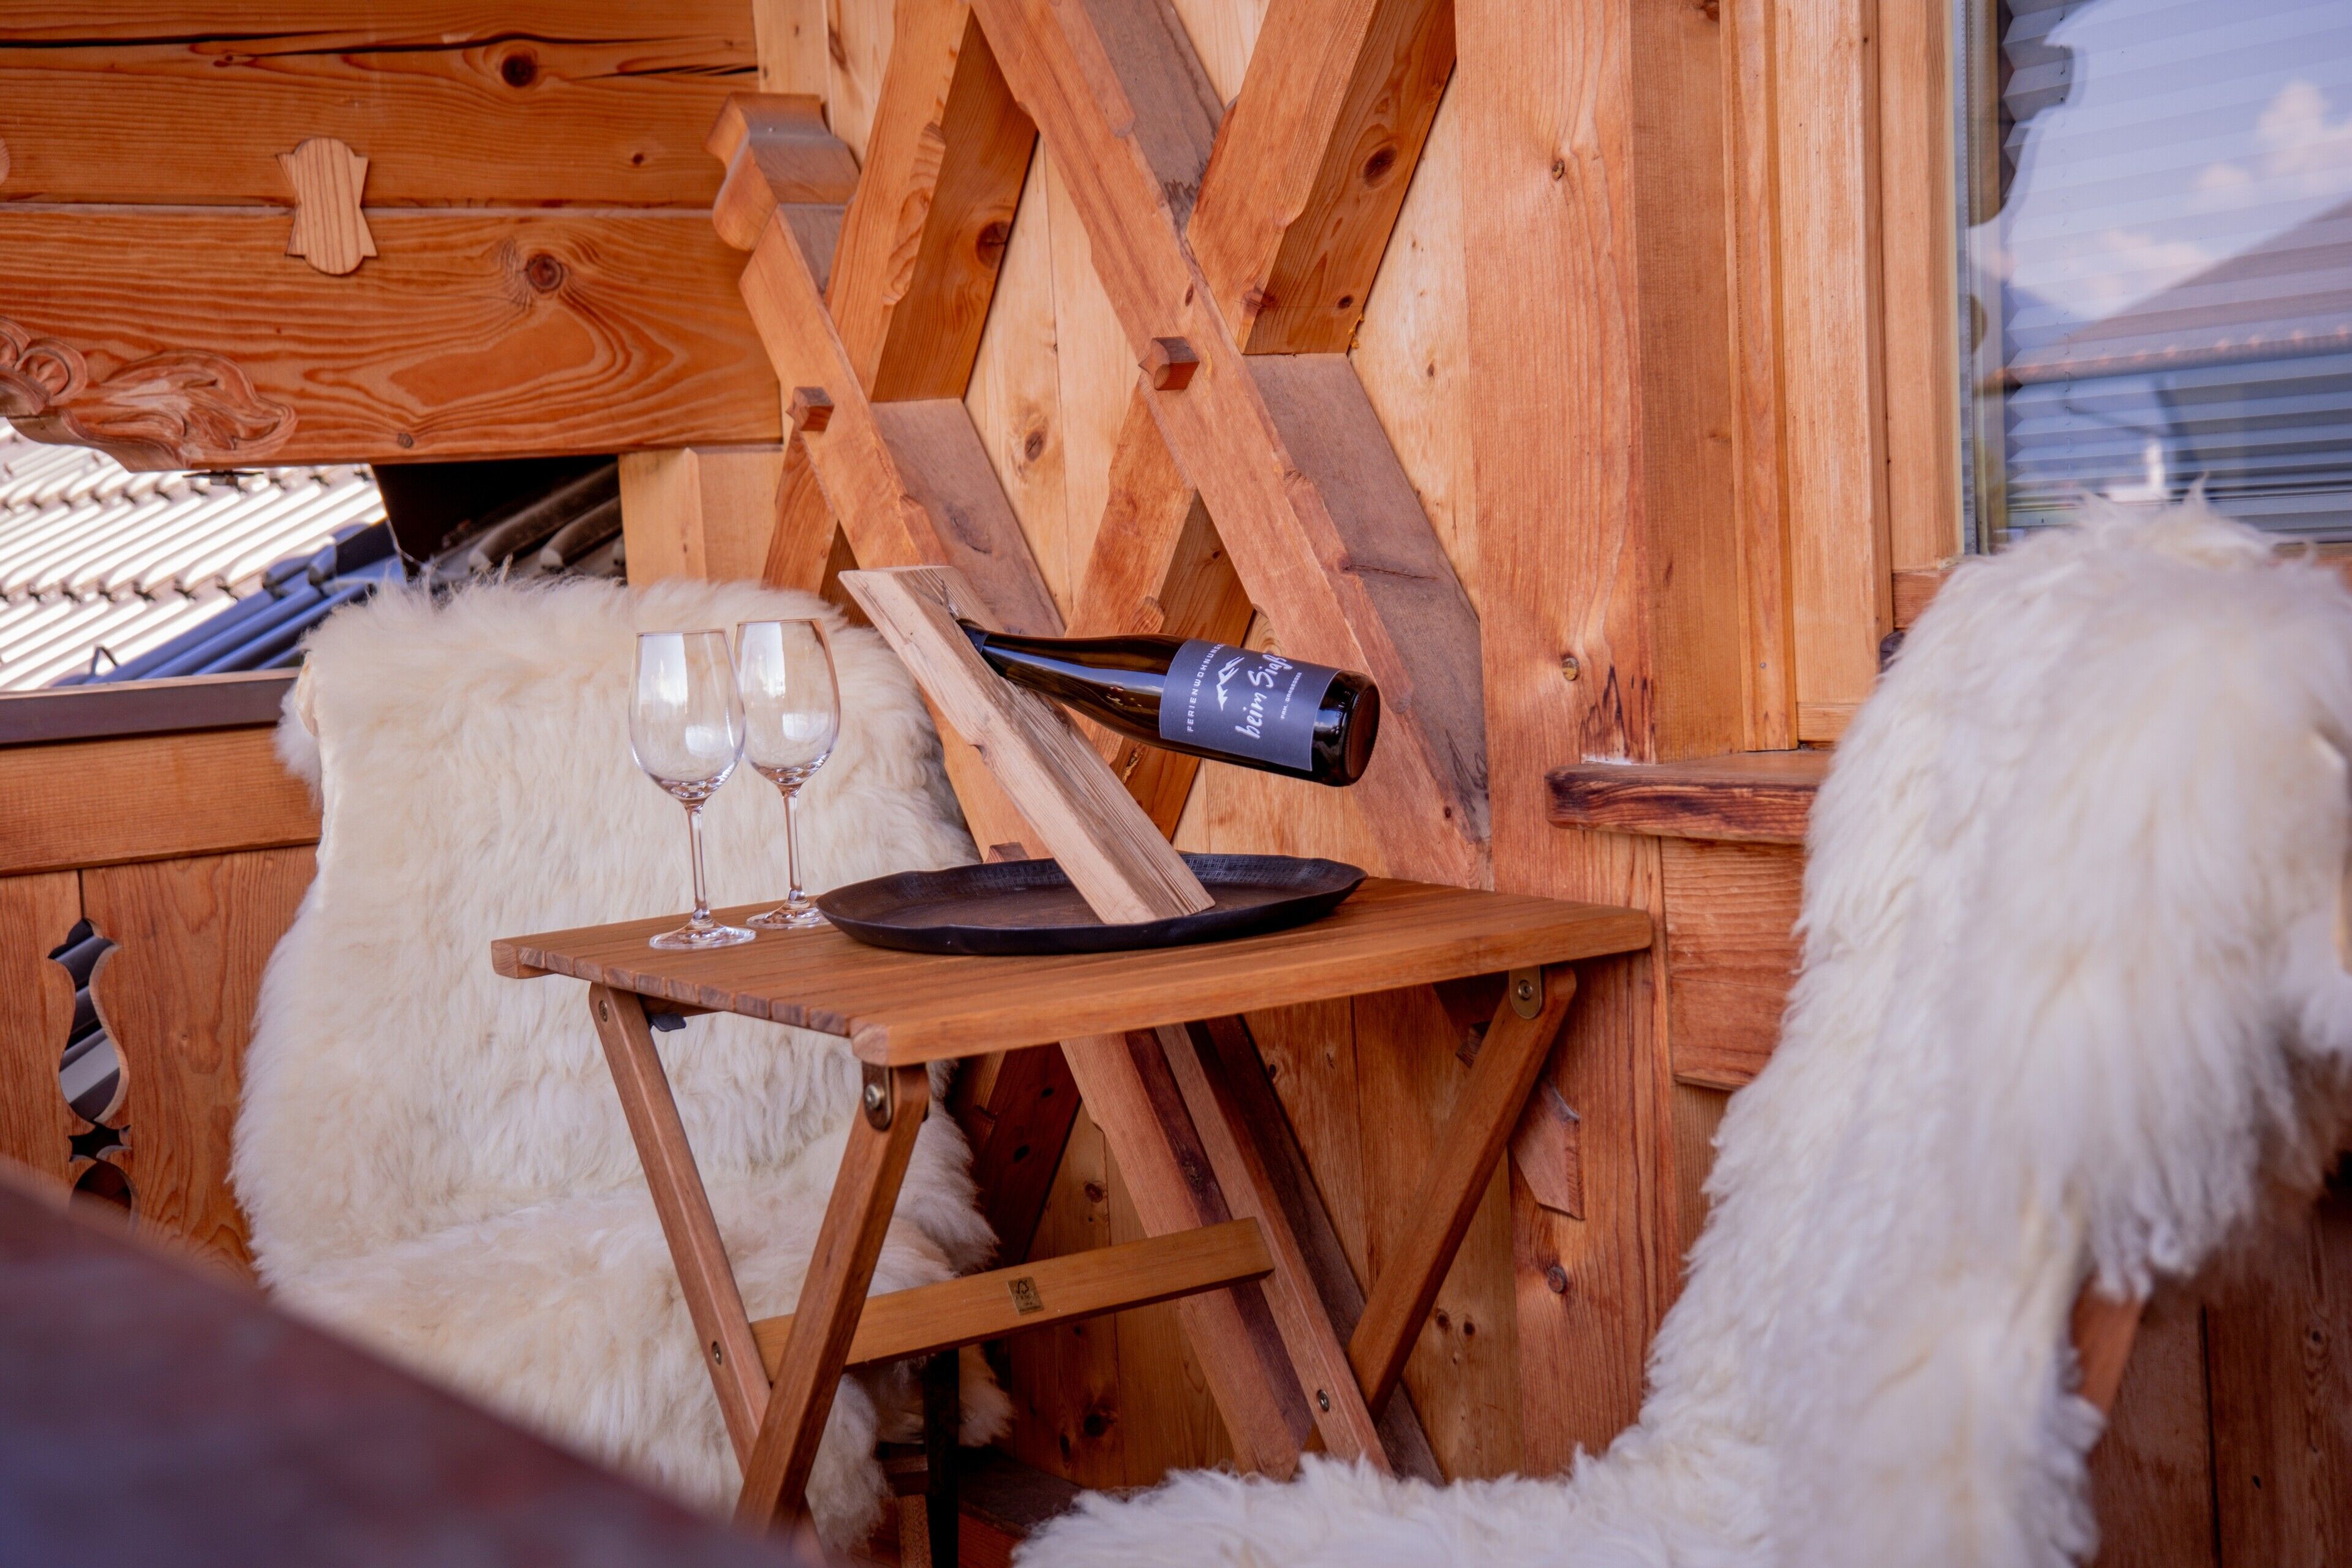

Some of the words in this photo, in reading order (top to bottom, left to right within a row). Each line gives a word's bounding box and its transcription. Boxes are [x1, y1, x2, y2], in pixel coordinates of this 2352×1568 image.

[1186, 643, 1225, 733] FERIENWOHNUNGE
[1247, 654, 1293, 688] Siaß
[1234, 692, 1267, 739] beim
